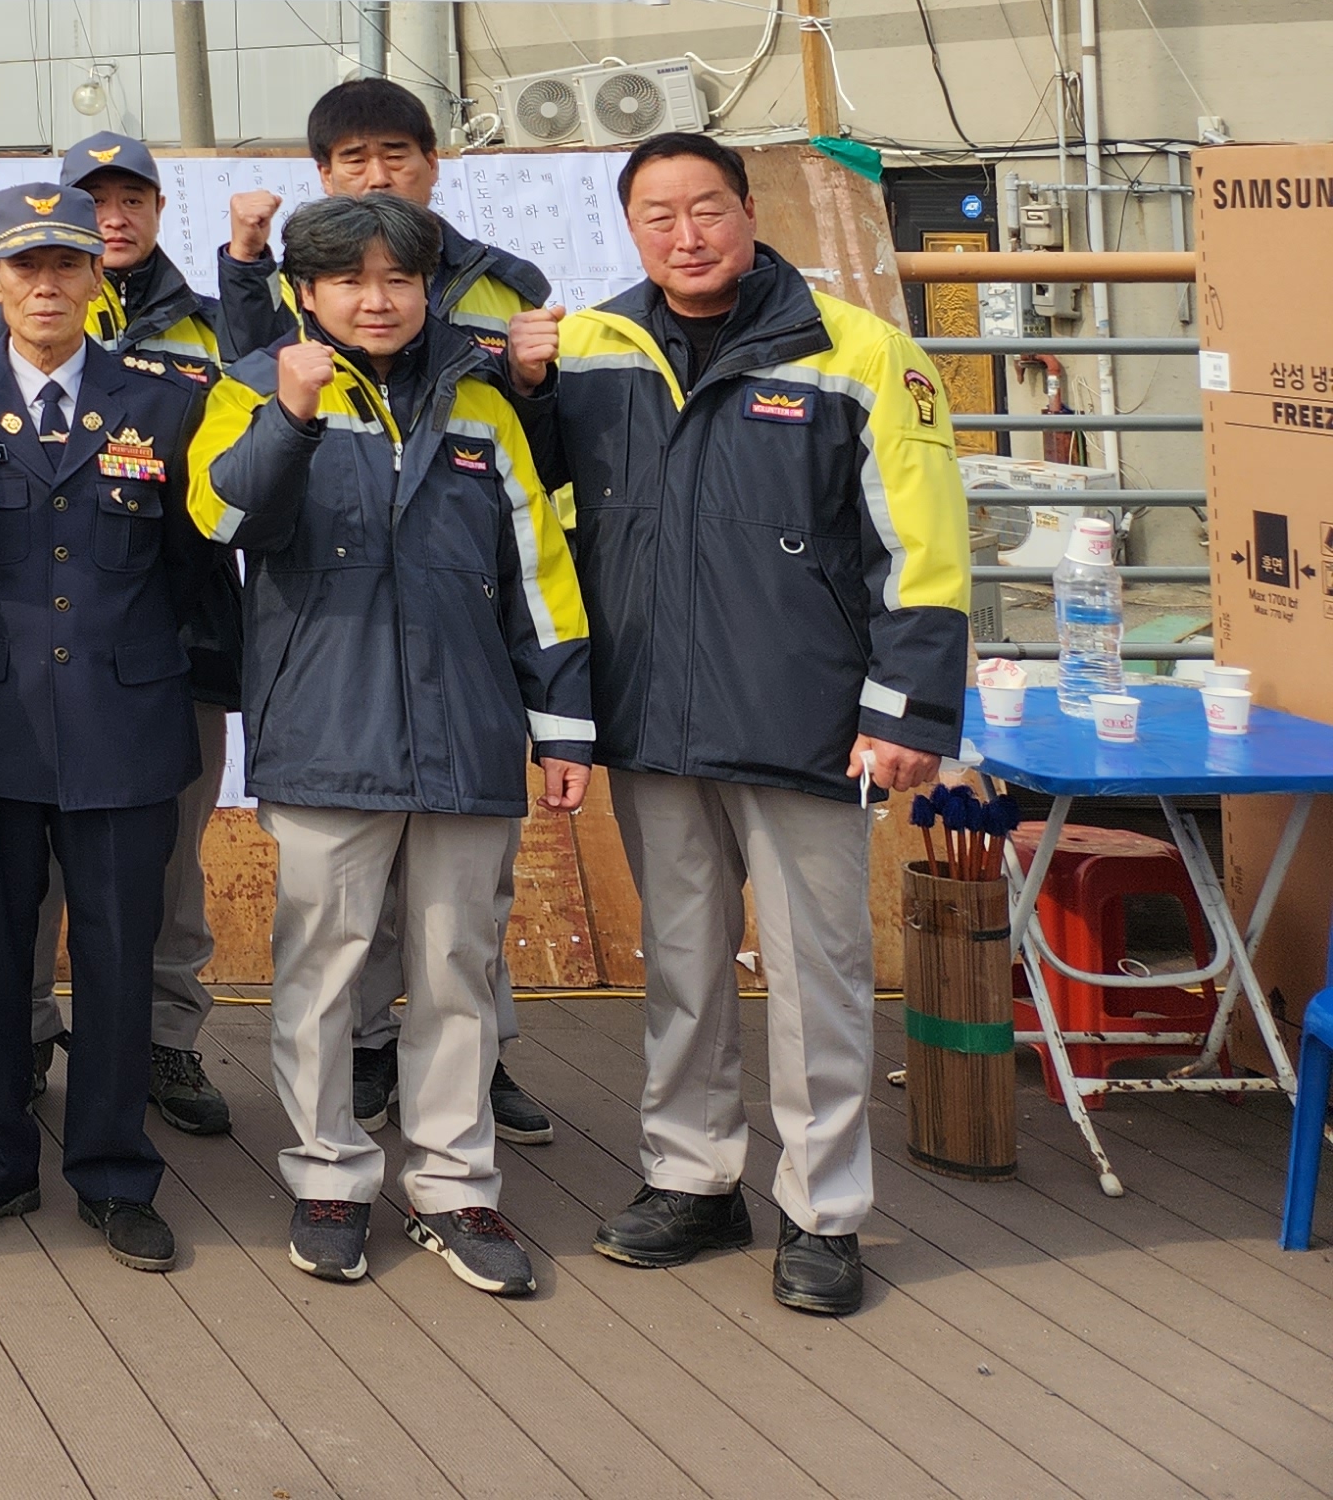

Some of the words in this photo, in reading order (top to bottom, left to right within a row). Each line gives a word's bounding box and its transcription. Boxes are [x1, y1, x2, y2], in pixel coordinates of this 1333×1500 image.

[1269, 361, 1305, 391] 삼성
[1260, 554, 1284, 576] 후면
[1248, 587, 1266, 603] Max
[1253, 604, 1268, 616] Max
